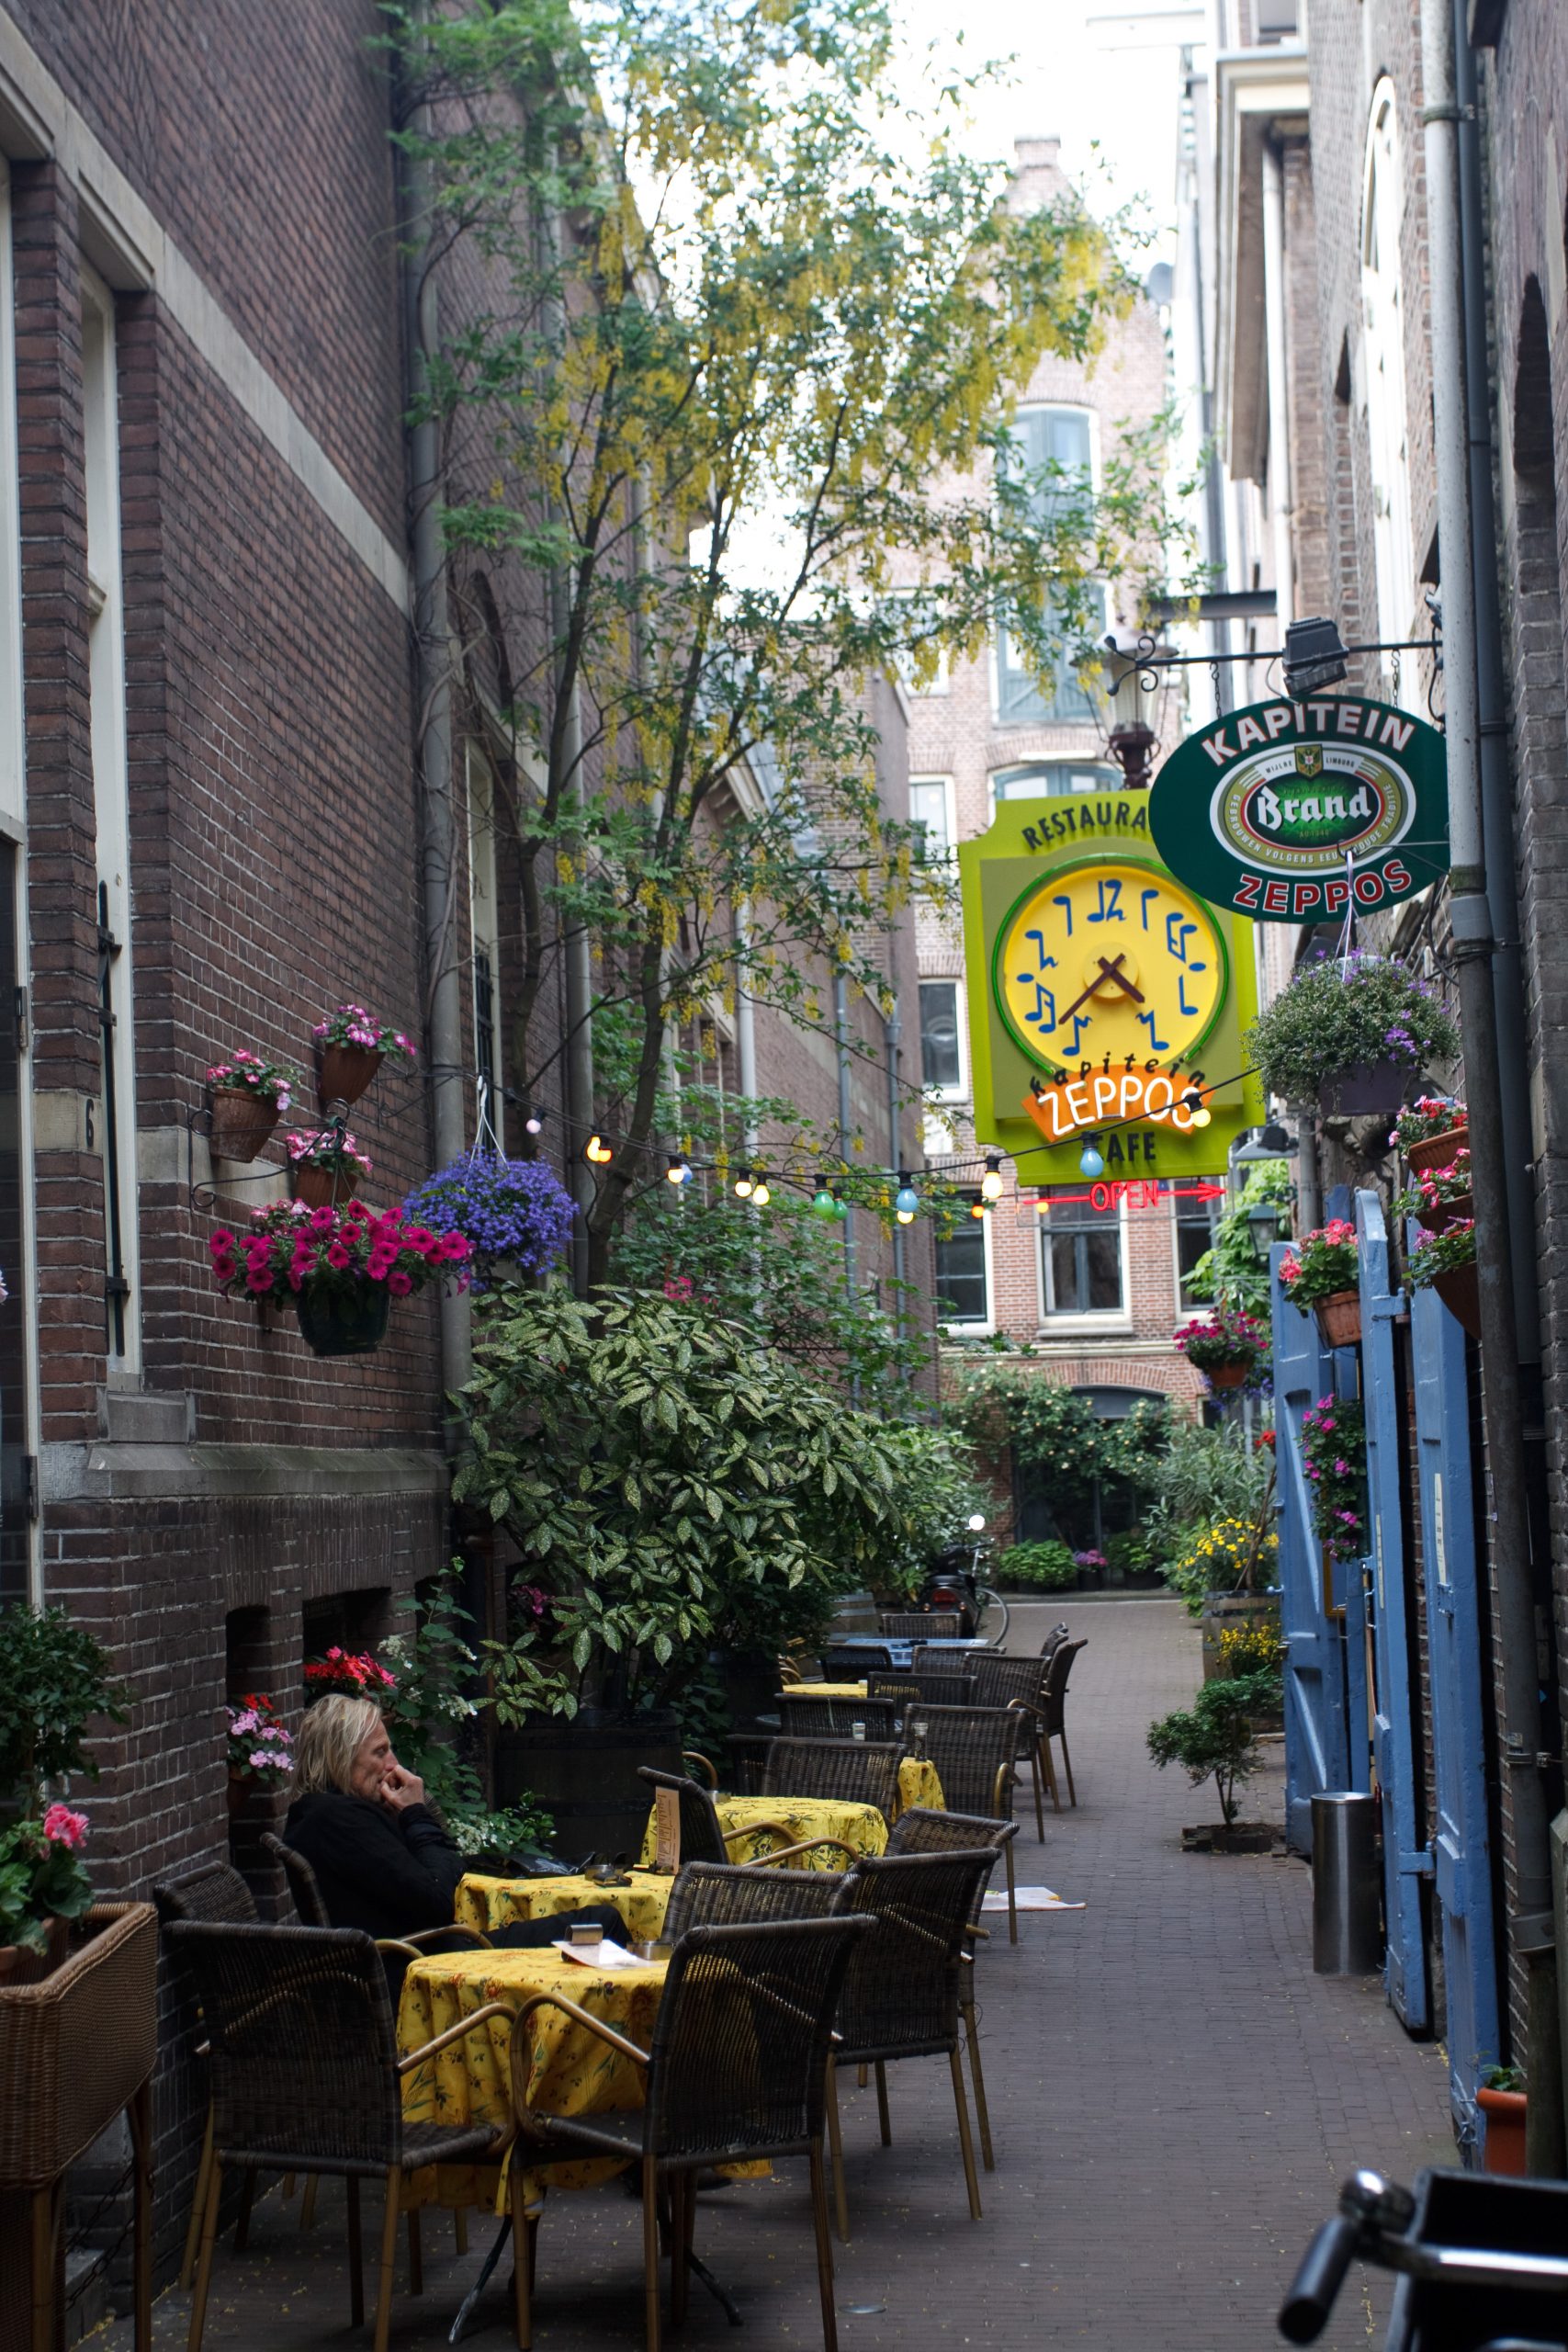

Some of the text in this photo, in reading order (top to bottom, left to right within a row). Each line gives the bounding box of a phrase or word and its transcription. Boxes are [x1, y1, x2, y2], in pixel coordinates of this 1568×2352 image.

[1201, 703, 1416, 766] KAPITEIN
[1021, 801, 1146, 851] RESTAURA
[1229, 794, 1262, 853] GEBROUWEN
[1266, 848, 1314, 864] VOLGENS
[1257, 786, 1371, 831] Brand
[1233, 859, 1412, 914] ZEPPOS
[85, 1098, 95, 1148] 6
[1038, 1075, 1202, 1136] ZEPPOS
[1095, 1131, 1156, 1162] AFE
[1090, 1180, 1160, 1212] OPEN
